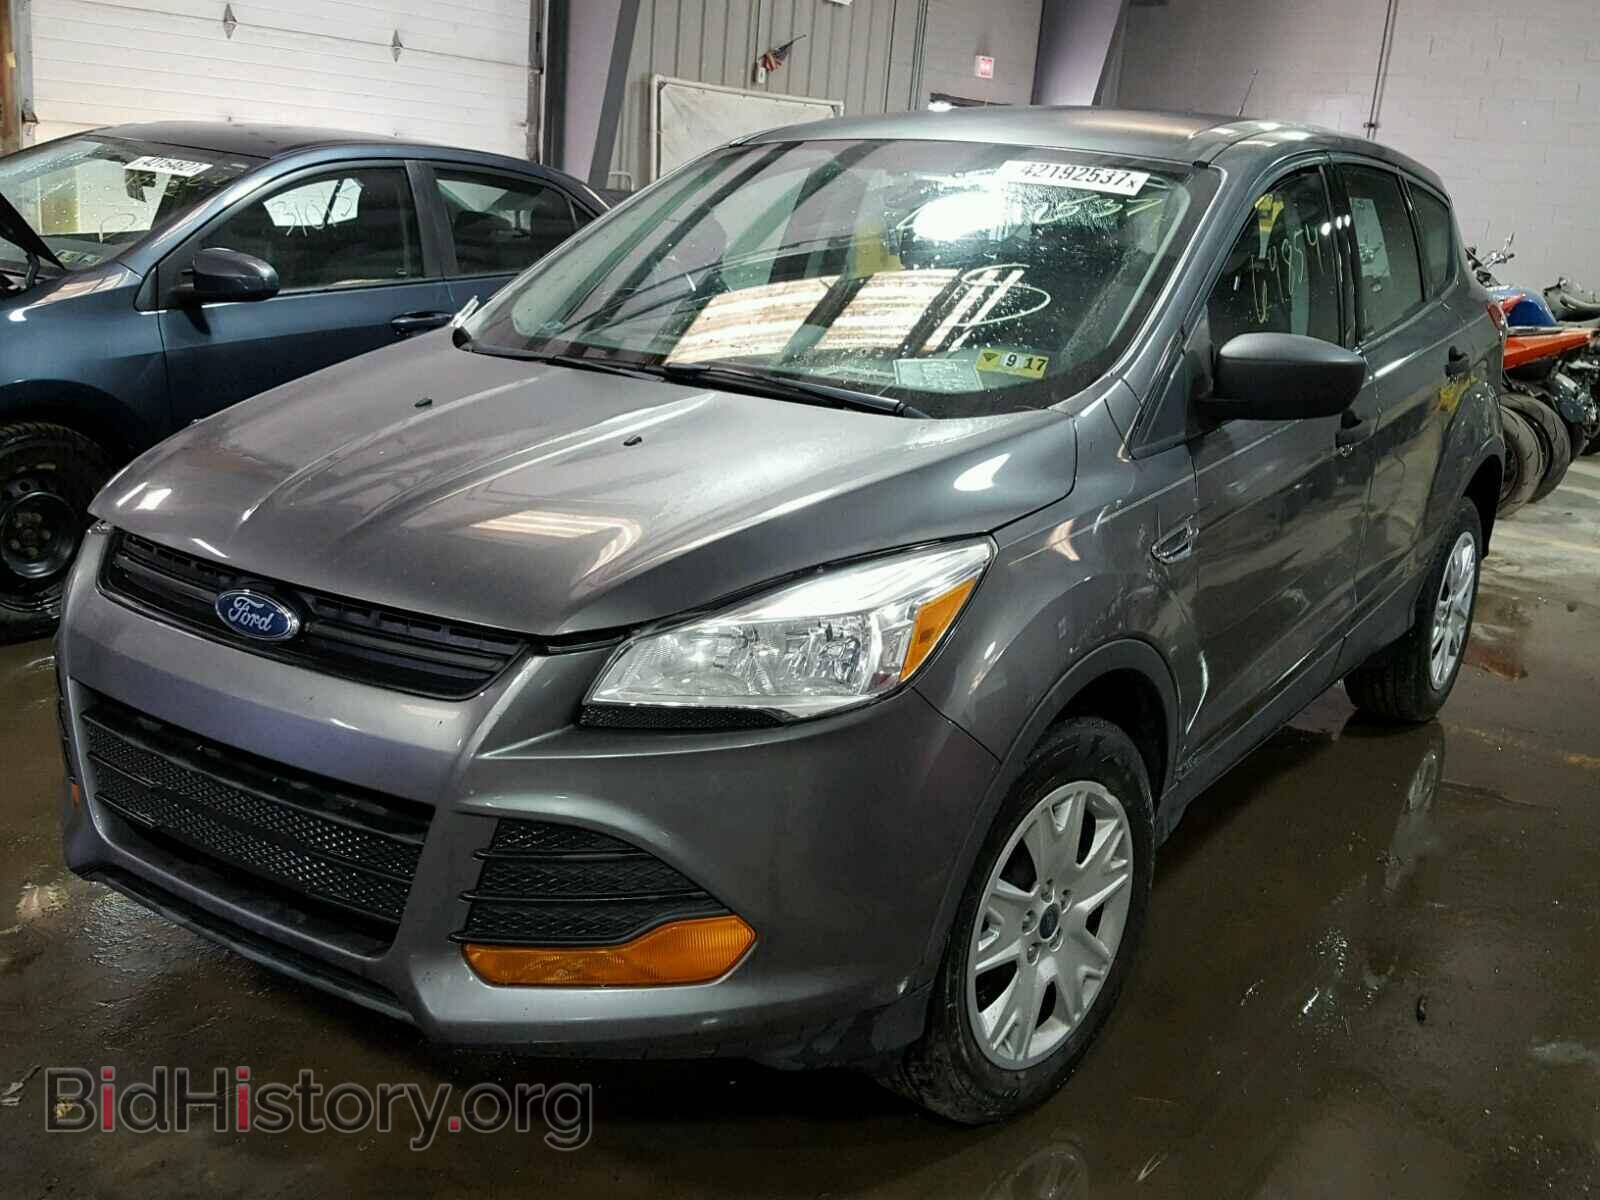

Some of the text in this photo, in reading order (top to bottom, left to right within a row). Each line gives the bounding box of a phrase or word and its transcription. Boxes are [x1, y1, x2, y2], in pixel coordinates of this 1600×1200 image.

[1006, 354, 1047, 372] 9 17
[228, 596, 272, 632] Ford
